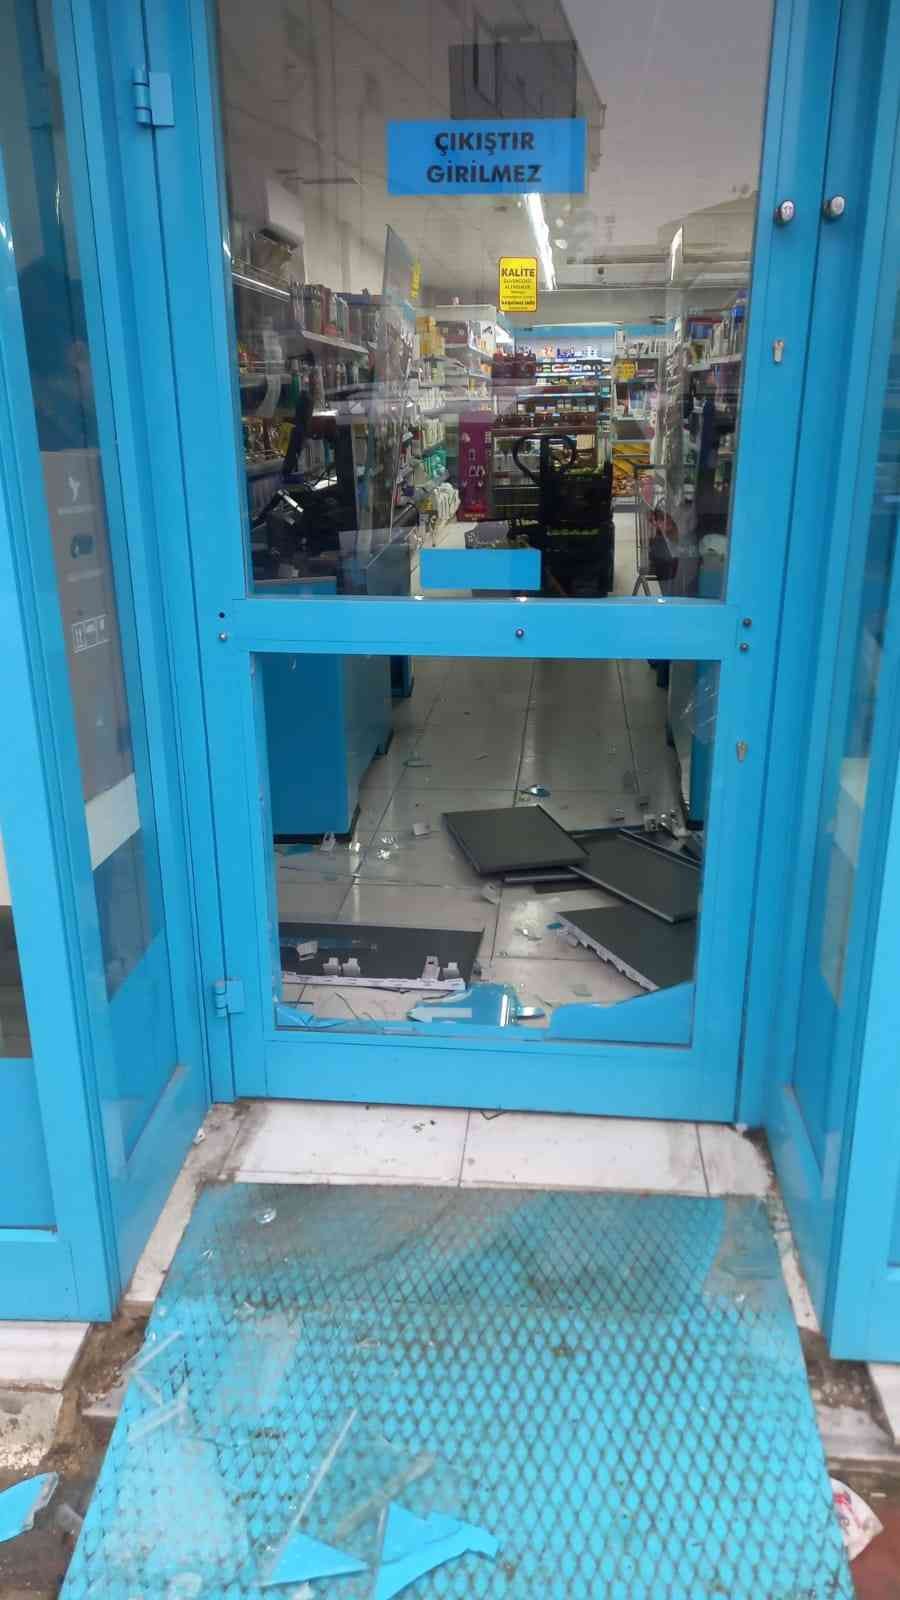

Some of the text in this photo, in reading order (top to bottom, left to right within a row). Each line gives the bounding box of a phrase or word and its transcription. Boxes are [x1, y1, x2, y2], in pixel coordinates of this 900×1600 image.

[434, 131, 535, 157] ÇIKIŞTIR
[426, 160, 544, 184] GİRİLMEZ
[501, 265, 536, 277] KALİTE
